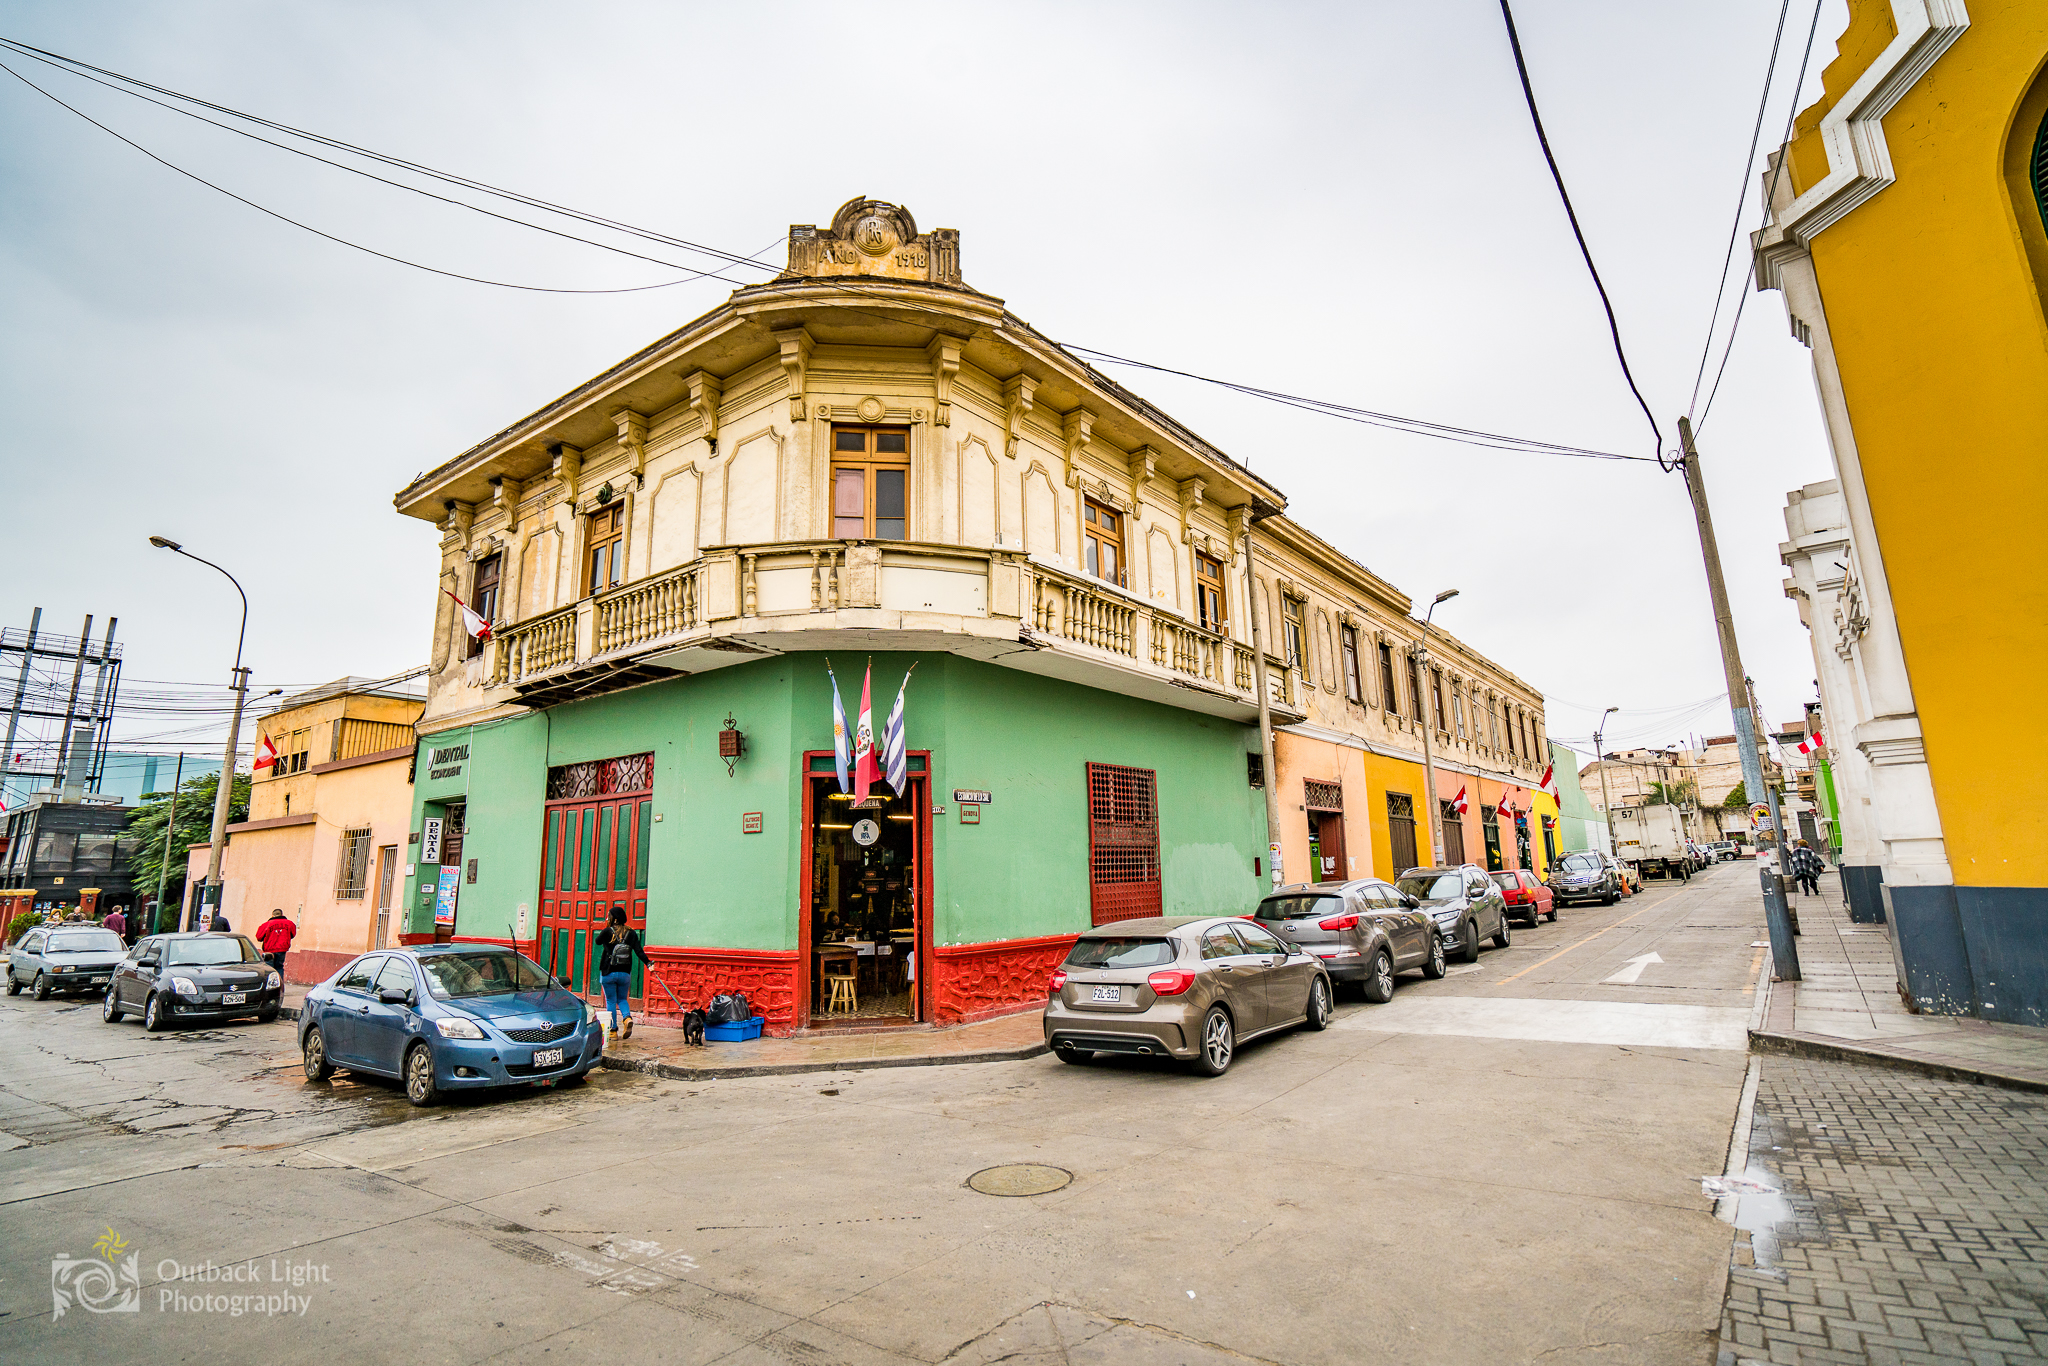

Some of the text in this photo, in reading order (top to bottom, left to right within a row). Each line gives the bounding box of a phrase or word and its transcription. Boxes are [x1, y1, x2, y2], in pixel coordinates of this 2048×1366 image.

[895, 253, 926, 267] 1918
[434, 744, 469, 765] DENTAL
[430, 766, 462, 780] ECONODENT
[426, 821, 440, 860] DENTAL
[1093, 988, 1119, 999] F2L-512
